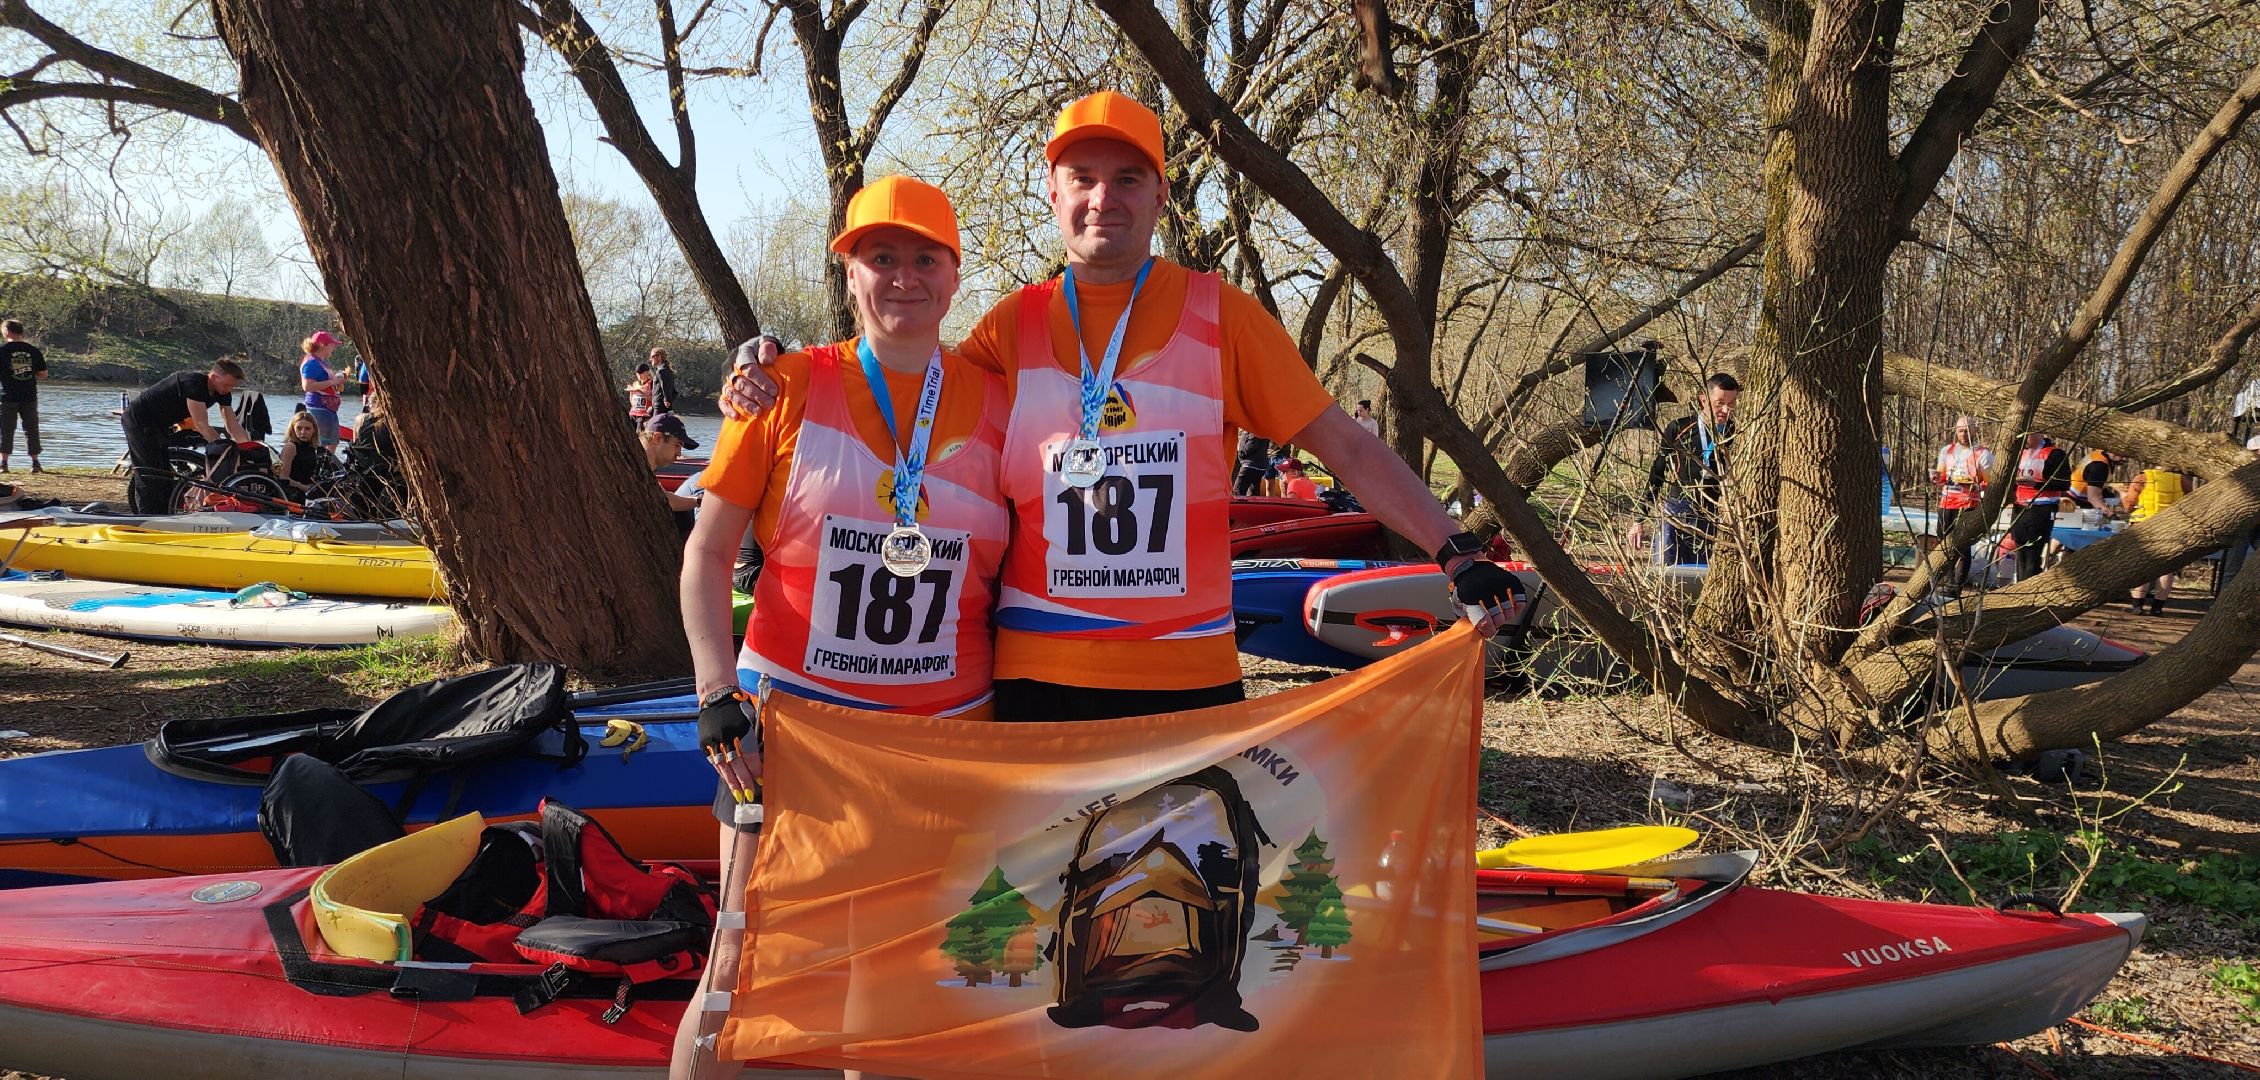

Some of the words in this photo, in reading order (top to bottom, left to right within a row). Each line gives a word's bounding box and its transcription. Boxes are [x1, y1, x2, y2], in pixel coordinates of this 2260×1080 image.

[921, 366, 940, 416] TimeTrial
[1052, 438, 1178, 472] МОРЕЦКИЙ
[1057, 475, 1173, 556] 187
[1053, 566, 1110, 587] ГРЕБНОЙ
[1113, 567, 1180, 587] МАРАФОН
[829, 563, 952, 645] 187
[813, 648, 878, 675] ГРЕБНОЙ
[880, 655, 950, 675] МАРАФОН
[1237, 745, 1300, 786] МКИ
[1842, 936, 1952, 968] VUOKSA
